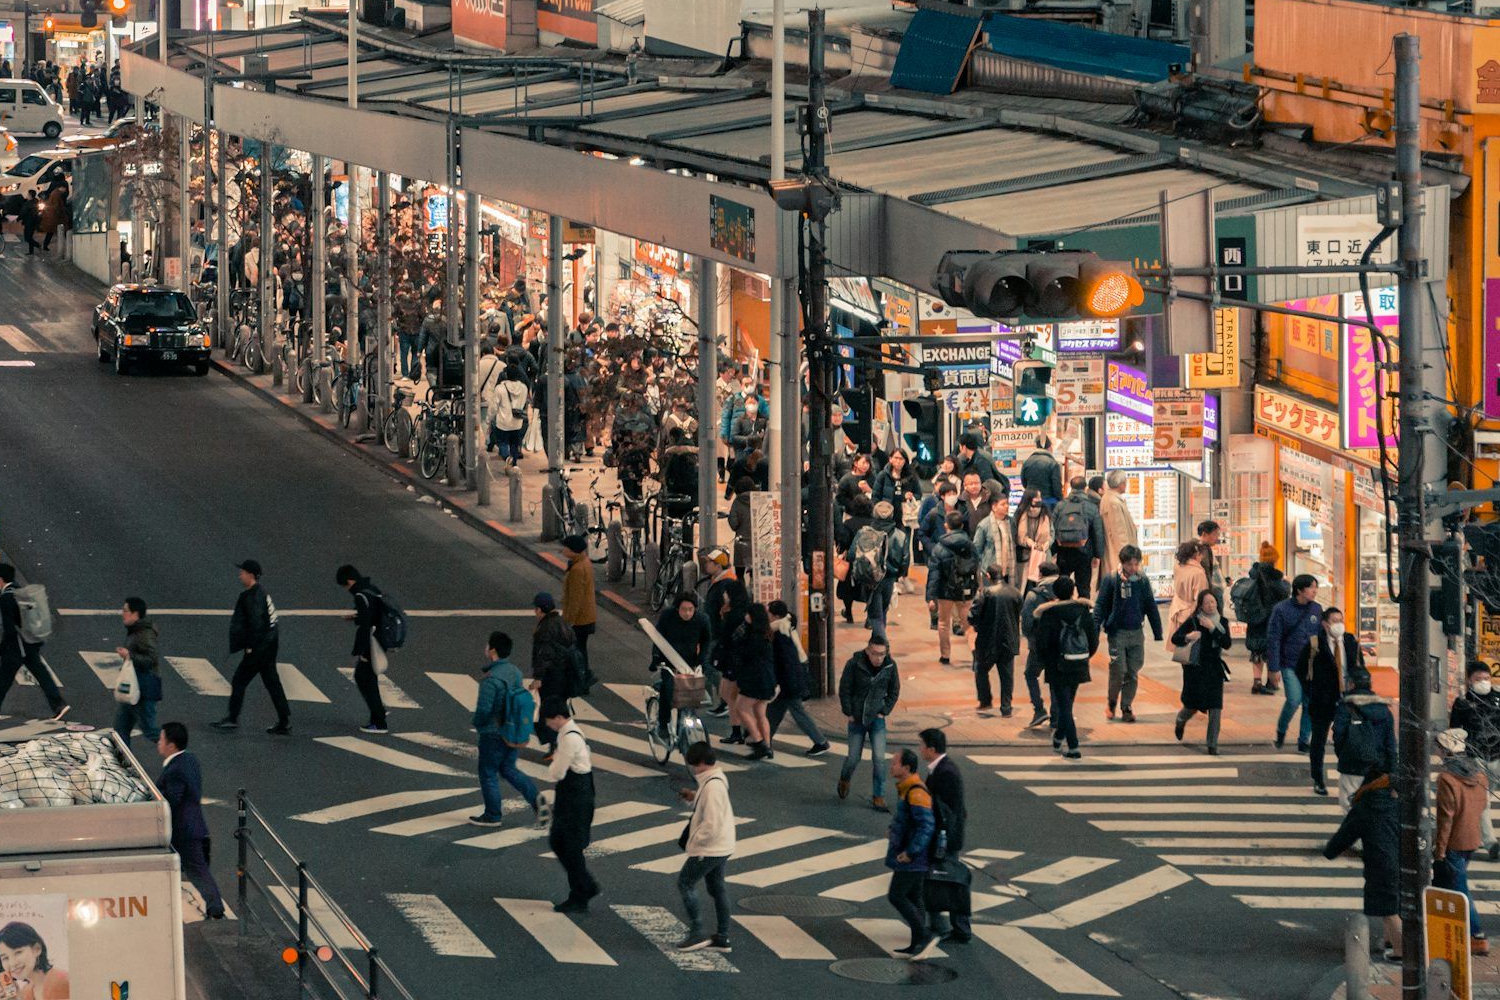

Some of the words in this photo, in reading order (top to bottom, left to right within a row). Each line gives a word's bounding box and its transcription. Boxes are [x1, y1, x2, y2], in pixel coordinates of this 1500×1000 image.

[1223, 247, 1243, 291] 西口
[923, 346, 991, 361] EXCHANGE
[1059, 339, 1118, 348] アクセスチケット
[1226, 319, 1235, 376] TRANSFER
[1260, 392, 1336, 441] ビックチケ
[994, 431, 1034, 441] amazon
